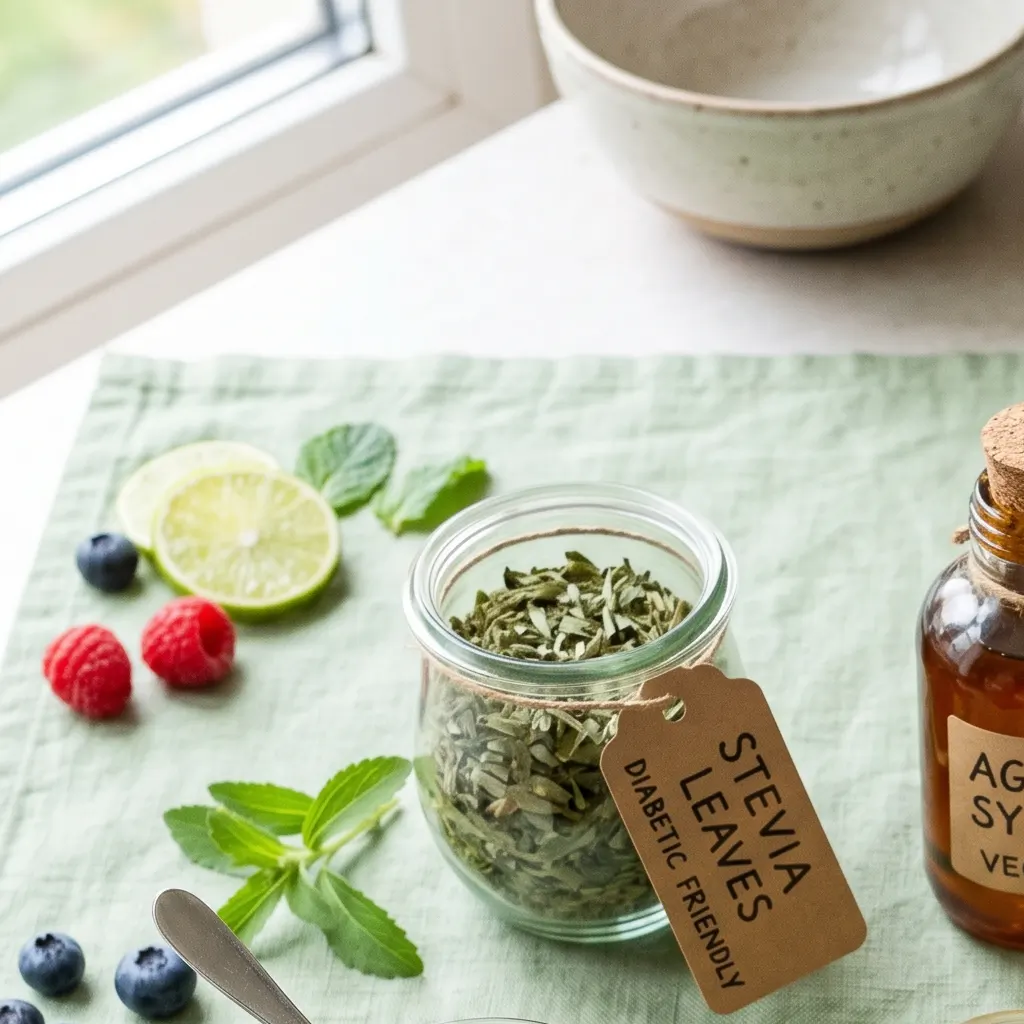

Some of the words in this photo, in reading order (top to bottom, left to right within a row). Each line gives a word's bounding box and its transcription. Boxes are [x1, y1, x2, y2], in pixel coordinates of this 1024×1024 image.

[624, 758, 687, 870] DIABETIC
[676, 876, 745, 988] FRIENDLY
[679, 767, 773, 922] LEAVES
[719, 732, 812, 894] STEVIA
